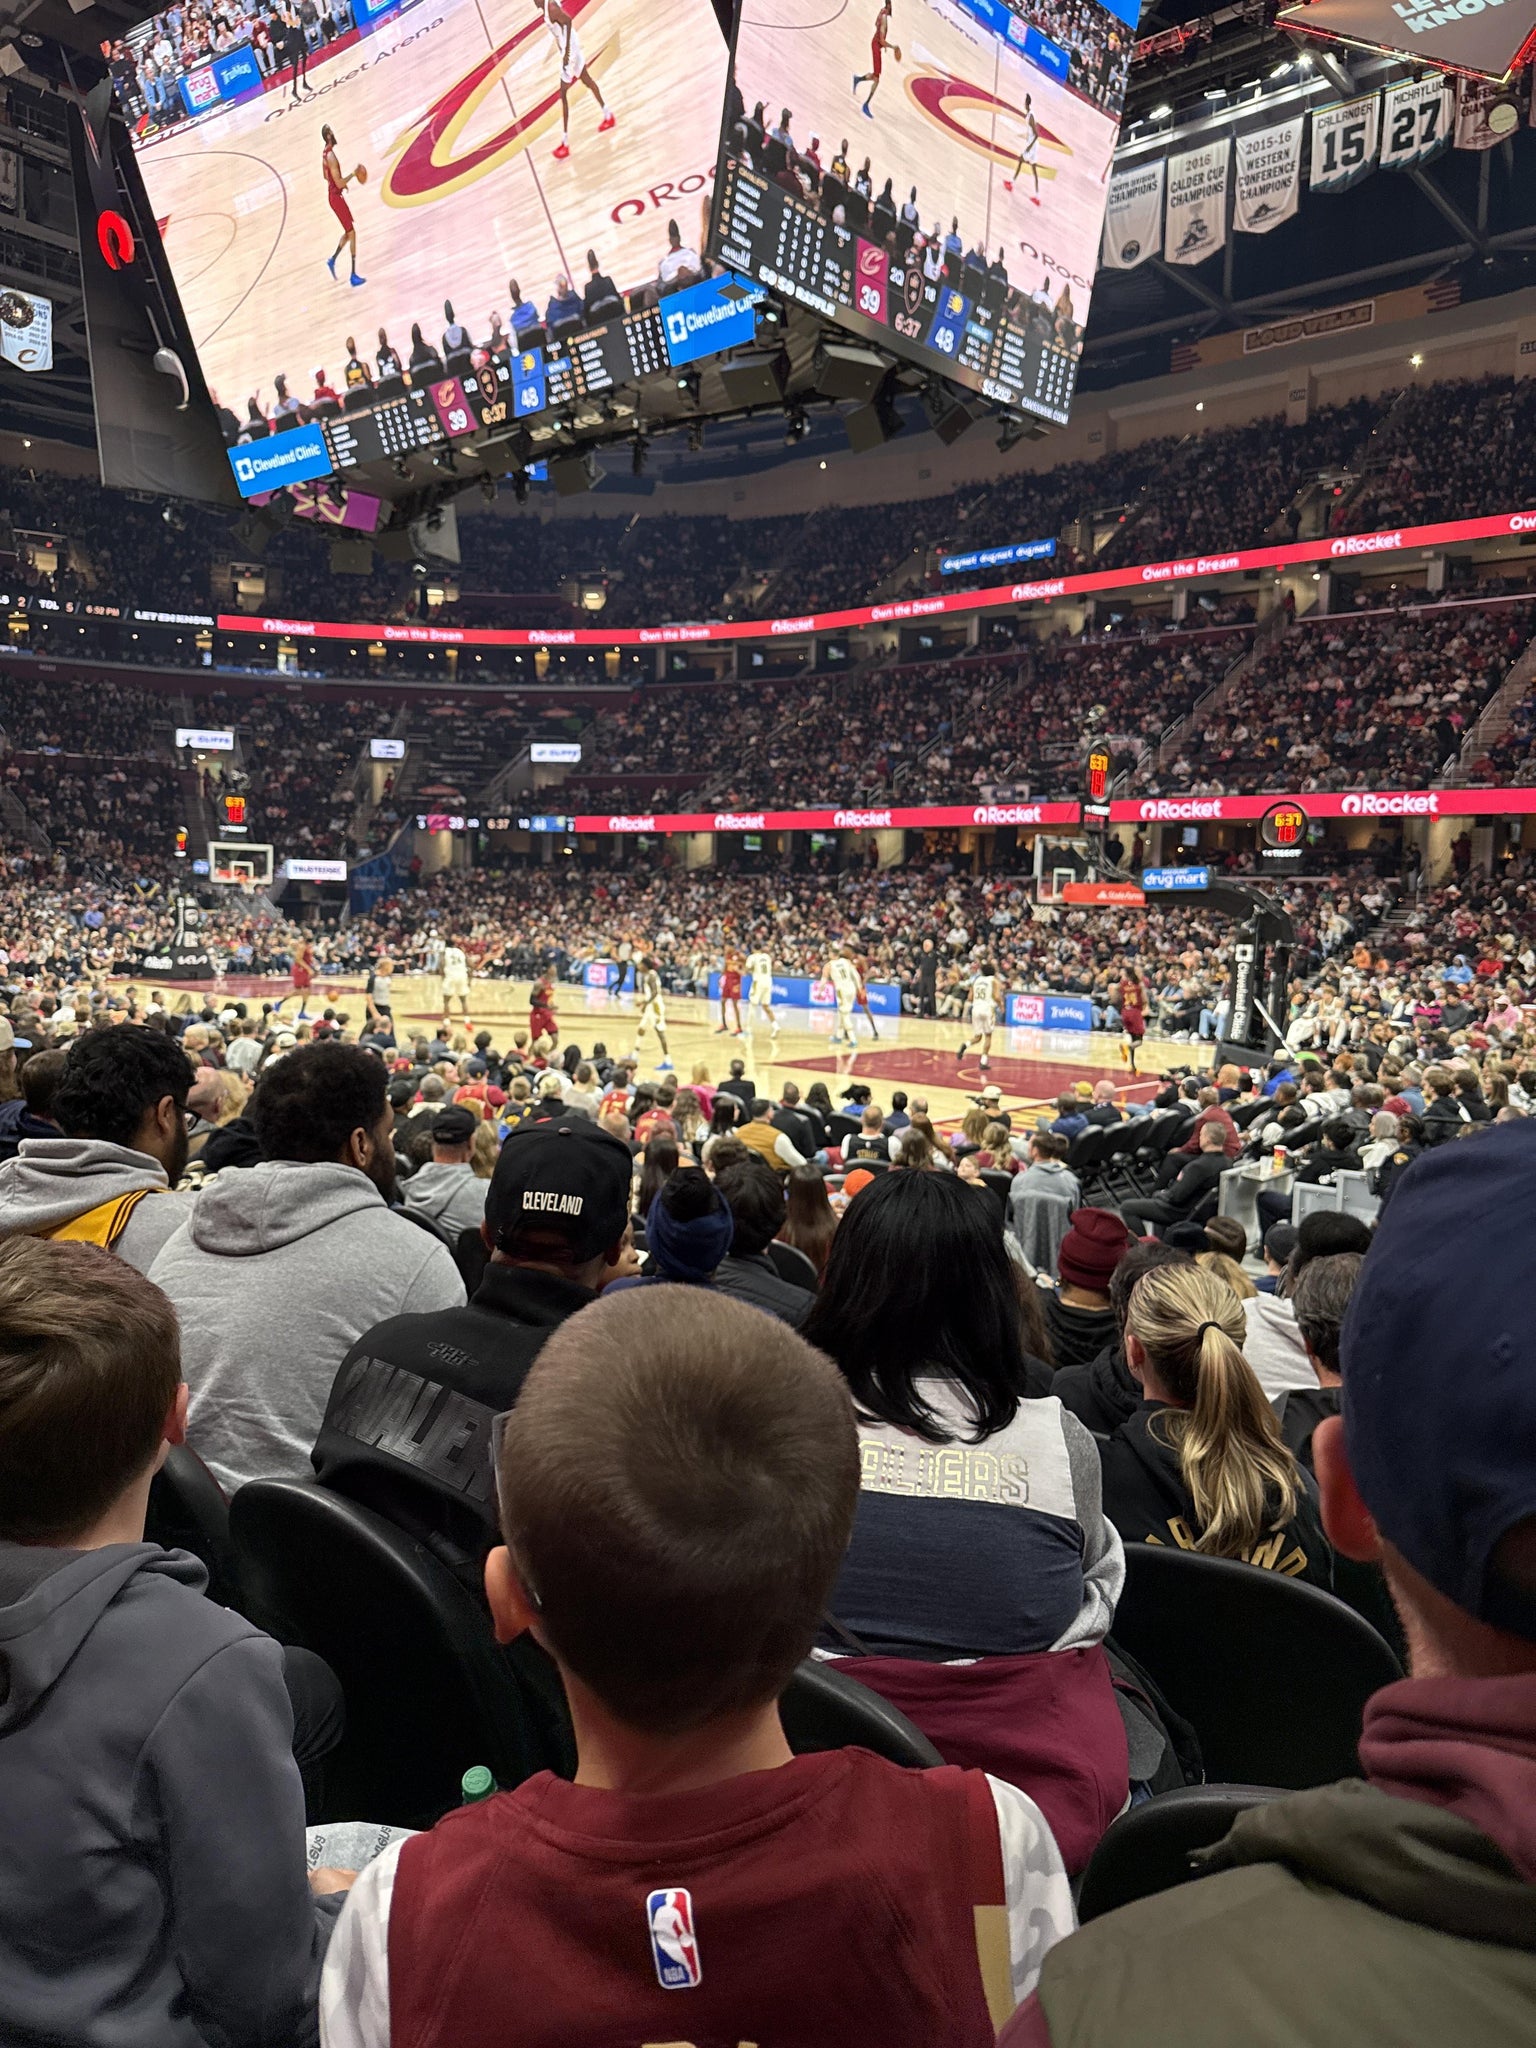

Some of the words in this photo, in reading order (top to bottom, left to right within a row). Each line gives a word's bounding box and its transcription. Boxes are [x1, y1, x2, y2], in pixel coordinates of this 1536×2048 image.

[1405, 0, 1511, 34] KNO
[289, 63, 370, 111] Rocket
[373, 16, 444, 66] Arena
[1317, 103, 1373, 129] CALLANDER
[1393, 98, 1442, 152] 27
[1246, 130, 1292, 155] 2015-16
[1322, 122, 1366, 174] 15
[1185, 154, 1211, 171] 2016
[1246, 148, 1290, 171] WESTERN
[1170, 173, 1205, 193] CALDER
[1207, 166, 1225, 181] CUP
[1238, 160, 1296, 187] CONFERENCE
[1109, 180, 1158, 205] CHAMPIONS
[1170, 181, 1224, 208] CHAMPIONS
[1240, 176, 1293, 201] CHAMPIONS
[860, 285, 880, 314] 39
[686, 301, 736, 331] Cleveland
[895, 312, 921, 339] 6:37
[935, 326, 954, 352] 48
[448, 409, 468, 431] 39
[481, 402, 506, 425] 6:37
[252, 448, 296, 473] Cleveland
[298, 443, 321, 461] Clinic
[1509, 516, 1536, 532] Ow
[1346, 534, 1401, 553] Rocket
[1143, 566, 1170, 580] Own
[1173, 561, 1195, 575] the
[1197, 557, 1239, 574] Dream
[1023, 581, 1065, 598] Rocket
[913, 600, 945, 614] Dream
[275, 620, 315, 635] Rocket
[781, 618, 814, 632] Rocket
[539, 631, 576, 643] Rocket
[987, 806, 1042, 823] Rocket
[1157, 800, 1222, 818] Rocket
[1361, 794, 1439, 814] Rocket
[619, 816, 655, 830] Rocket
[725, 814, 765, 829] Rocket
[845, 810, 892, 827] Rocket
[1144, 874, 1173, 889] drug
[1175, 873, 1208, 885] mart
[1235, 962, 1250, 1011] Cleveland
[523, 1191, 583, 1215] CLEVELAND
[859, 1440, 1030, 1507] ALIERS
[664, 1966, 686, 1982] NBA
